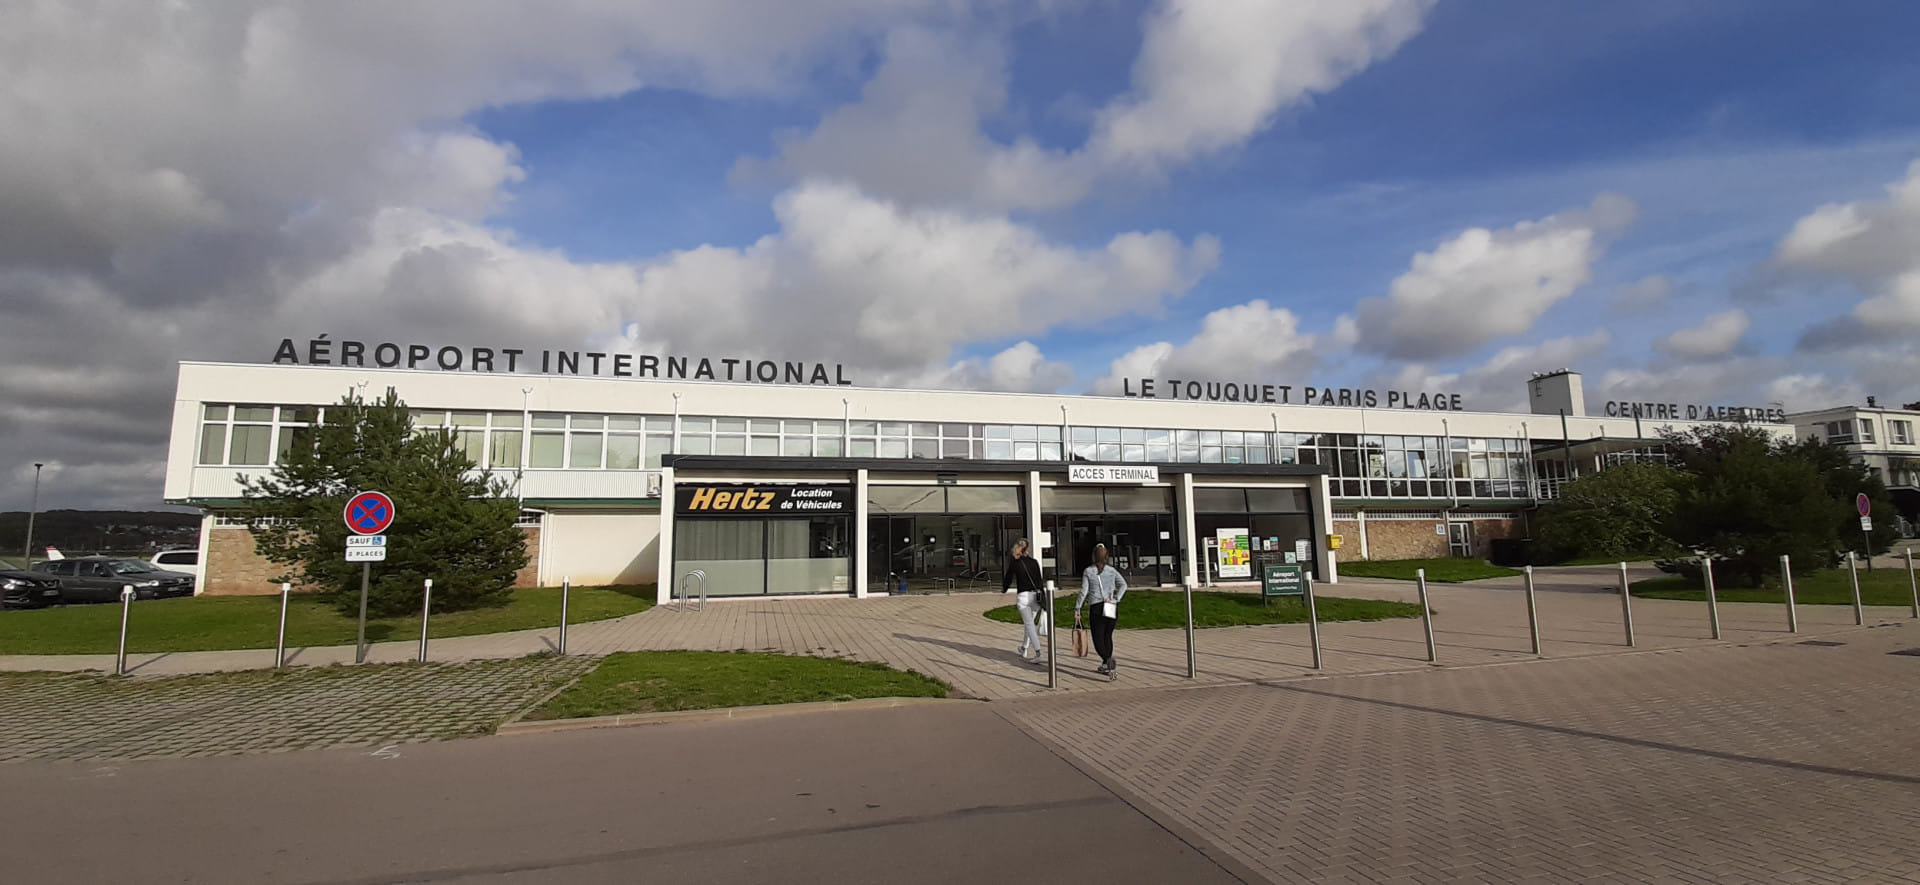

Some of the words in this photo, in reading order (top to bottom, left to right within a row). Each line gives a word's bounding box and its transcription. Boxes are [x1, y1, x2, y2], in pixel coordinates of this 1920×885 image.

[272, 333, 524, 372] AÉROPORT
[542, 350, 852, 385] INTERNATIONAL
[1124, 377, 1155, 397] LE
[1168, 380, 1292, 405] TOUQUET
[1304, 386, 1377, 408] PARIS
[1387, 390, 1463, 411] PLAGE
[1606, 400, 1680, 420] CENTRE
[1072, 468, 1105, 479] ACCES
[1109, 469, 1156, 480] TERMINAL
[688, 487, 776, 510] Hertz
[790, 488, 833, 498] Location
[780, 500, 793, 510] de
[796, 500, 843, 510] Véhicules
